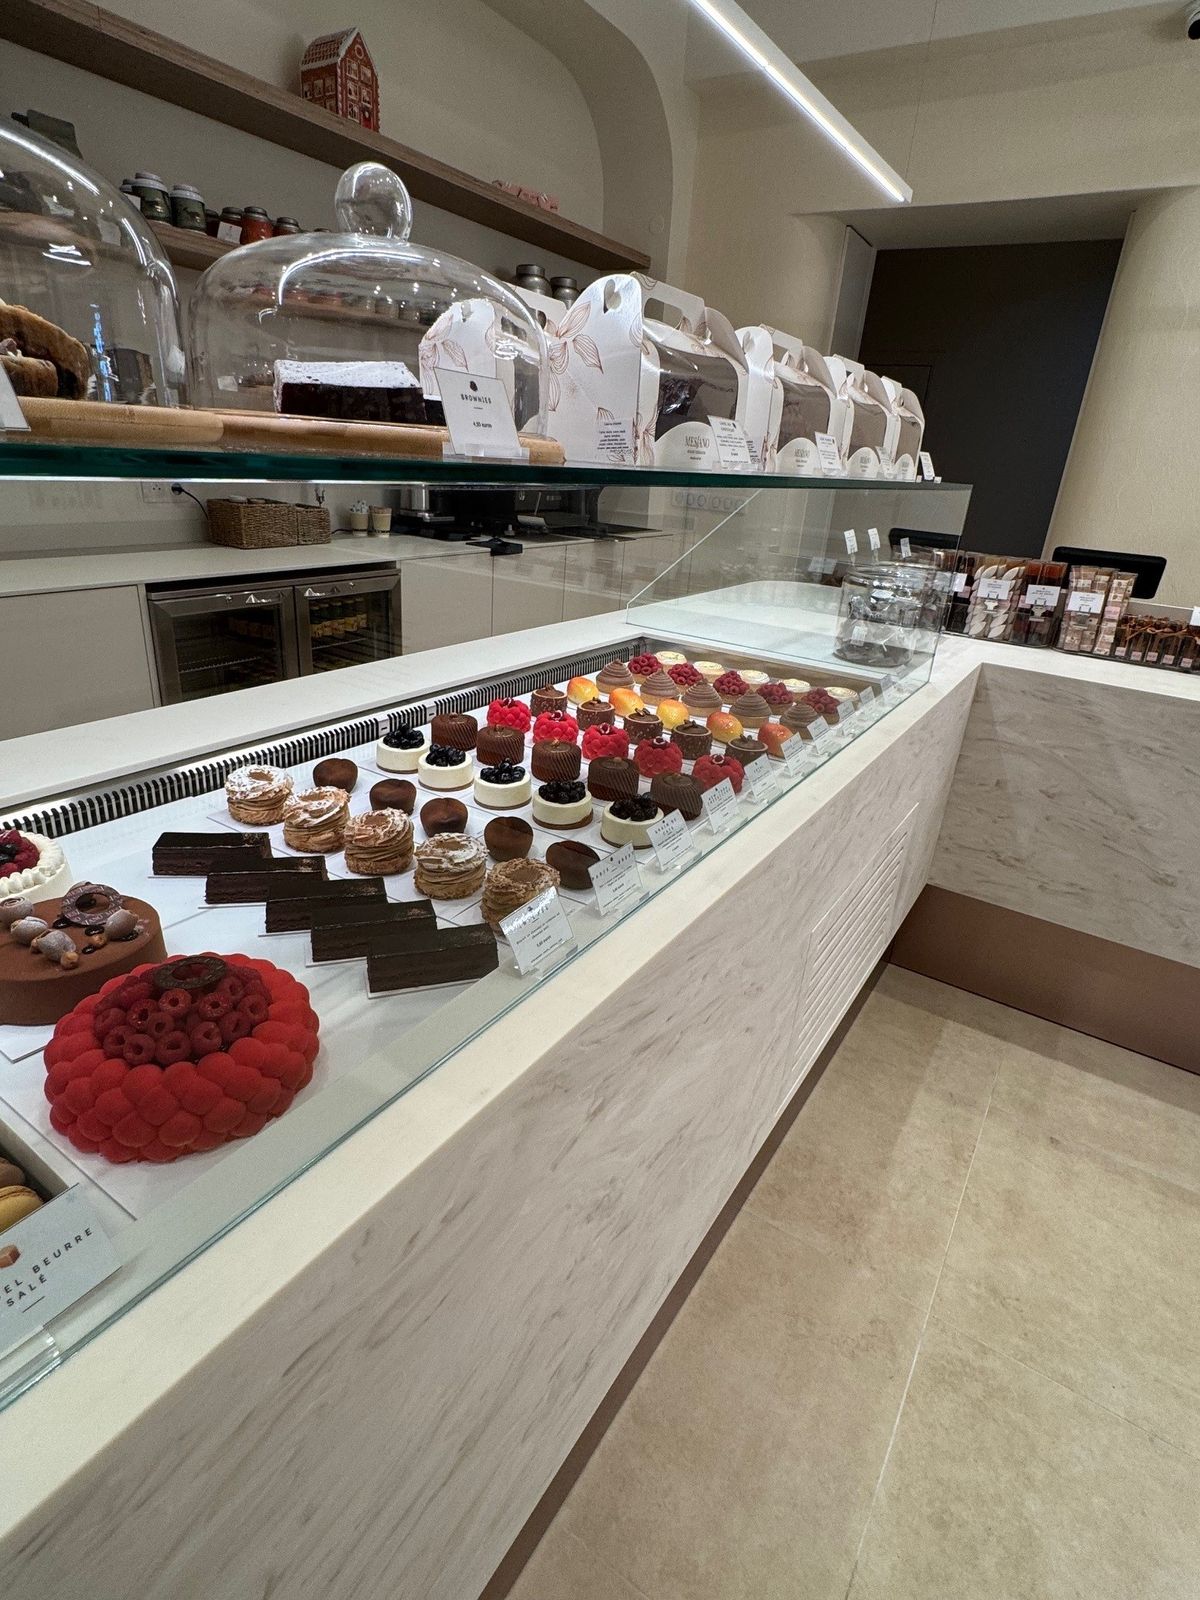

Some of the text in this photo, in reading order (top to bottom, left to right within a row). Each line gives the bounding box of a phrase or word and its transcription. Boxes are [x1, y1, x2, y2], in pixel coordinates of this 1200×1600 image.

[0, 1227, 93, 1298] EL BEURRE
[6, 1273, 47, 1307] SALÉ
